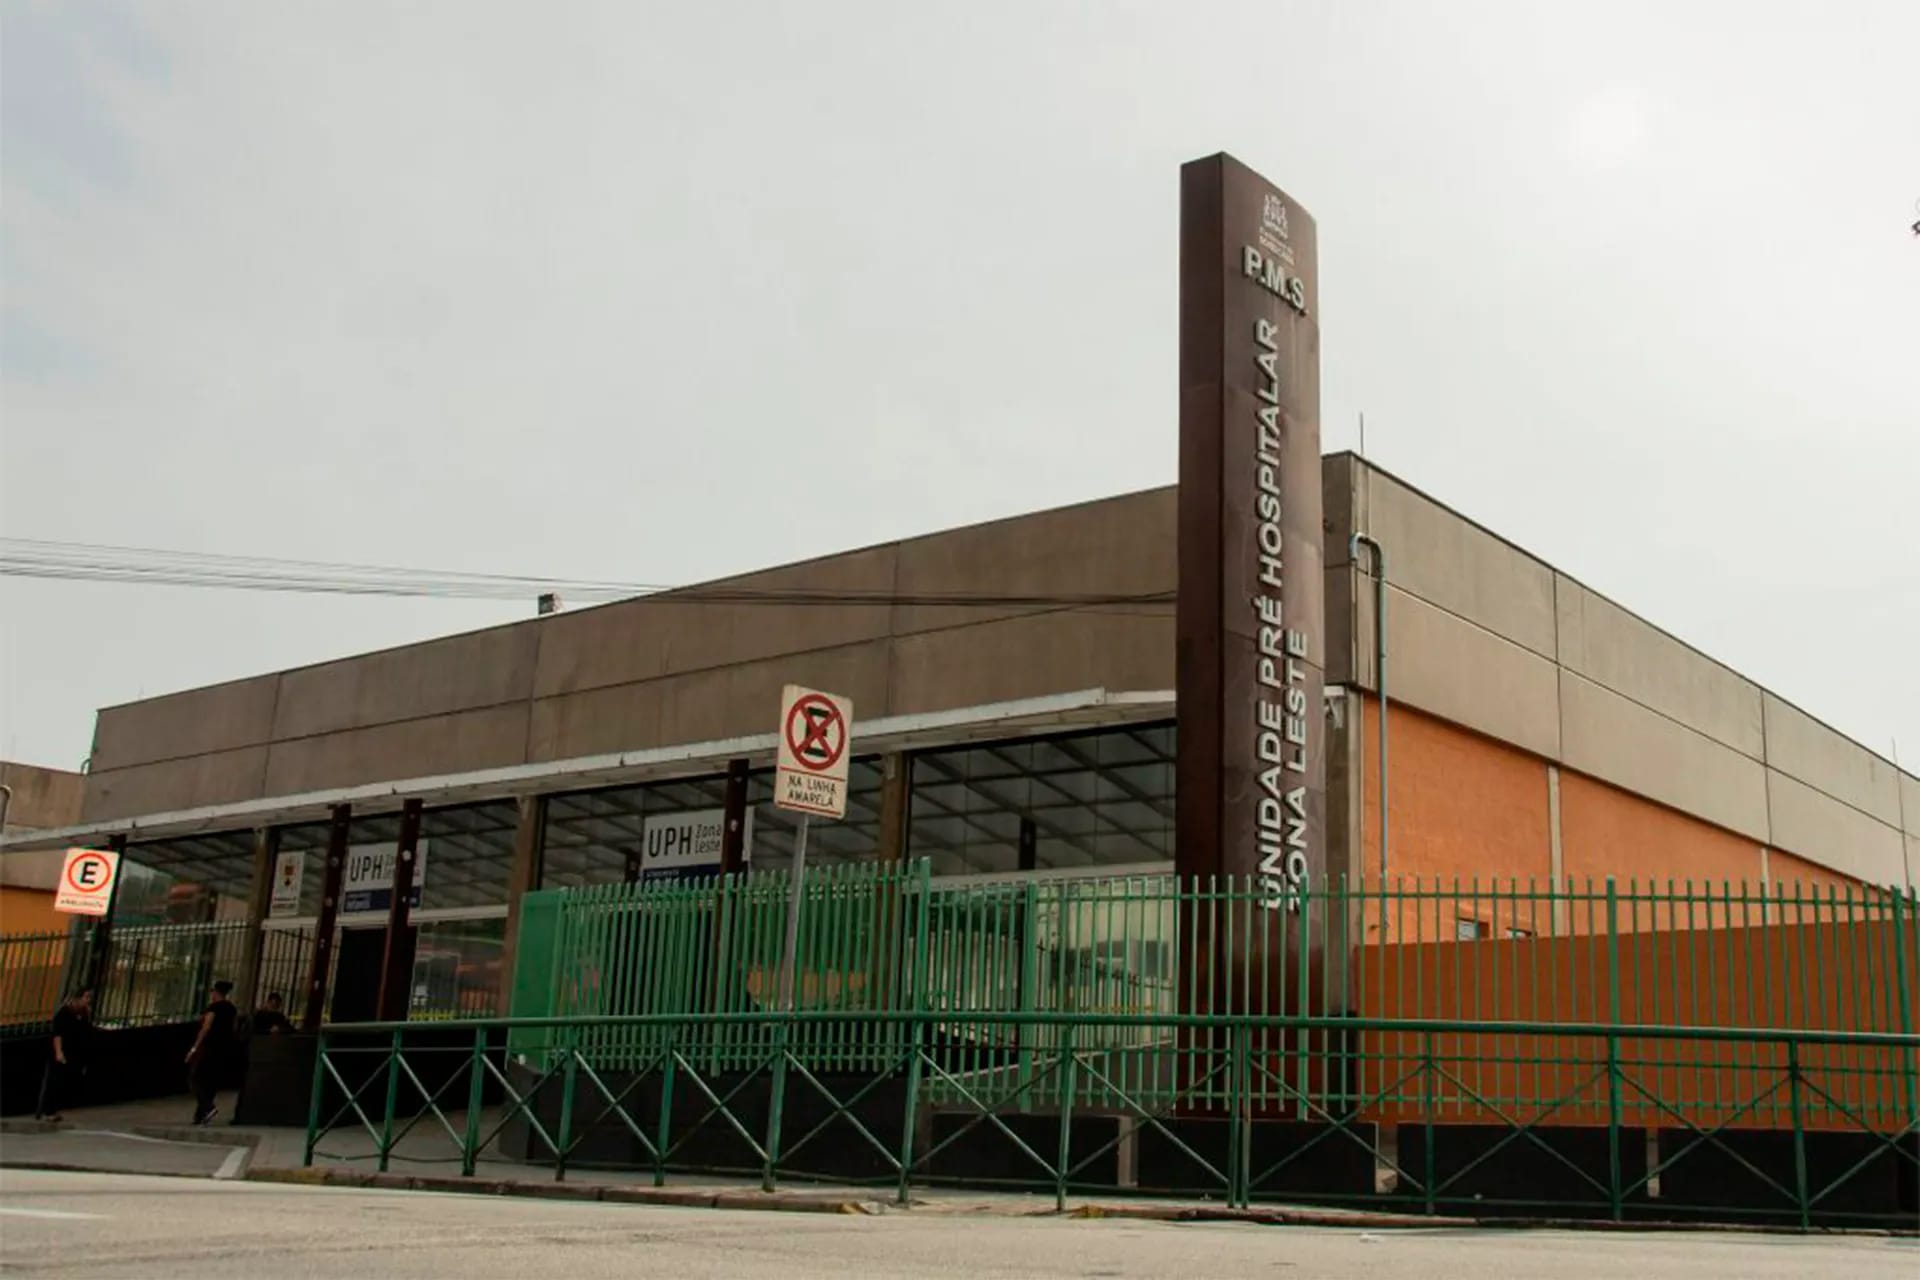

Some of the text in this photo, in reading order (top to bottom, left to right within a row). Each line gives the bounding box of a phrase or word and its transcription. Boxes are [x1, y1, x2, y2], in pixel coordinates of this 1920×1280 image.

[1255, 319, 1282, 910] UNIDADE PRÉ HOSPITALAR
[1286, 629, 1308, 773] LESTE
[787, 789, 835, 808] AMARELA
[788, 775, 836, 795] NA LINHA
[649, 824, 721, 857] UPH Zona
[80, 861, 99, 884] E
[350, 854, 384, 882] UPH
